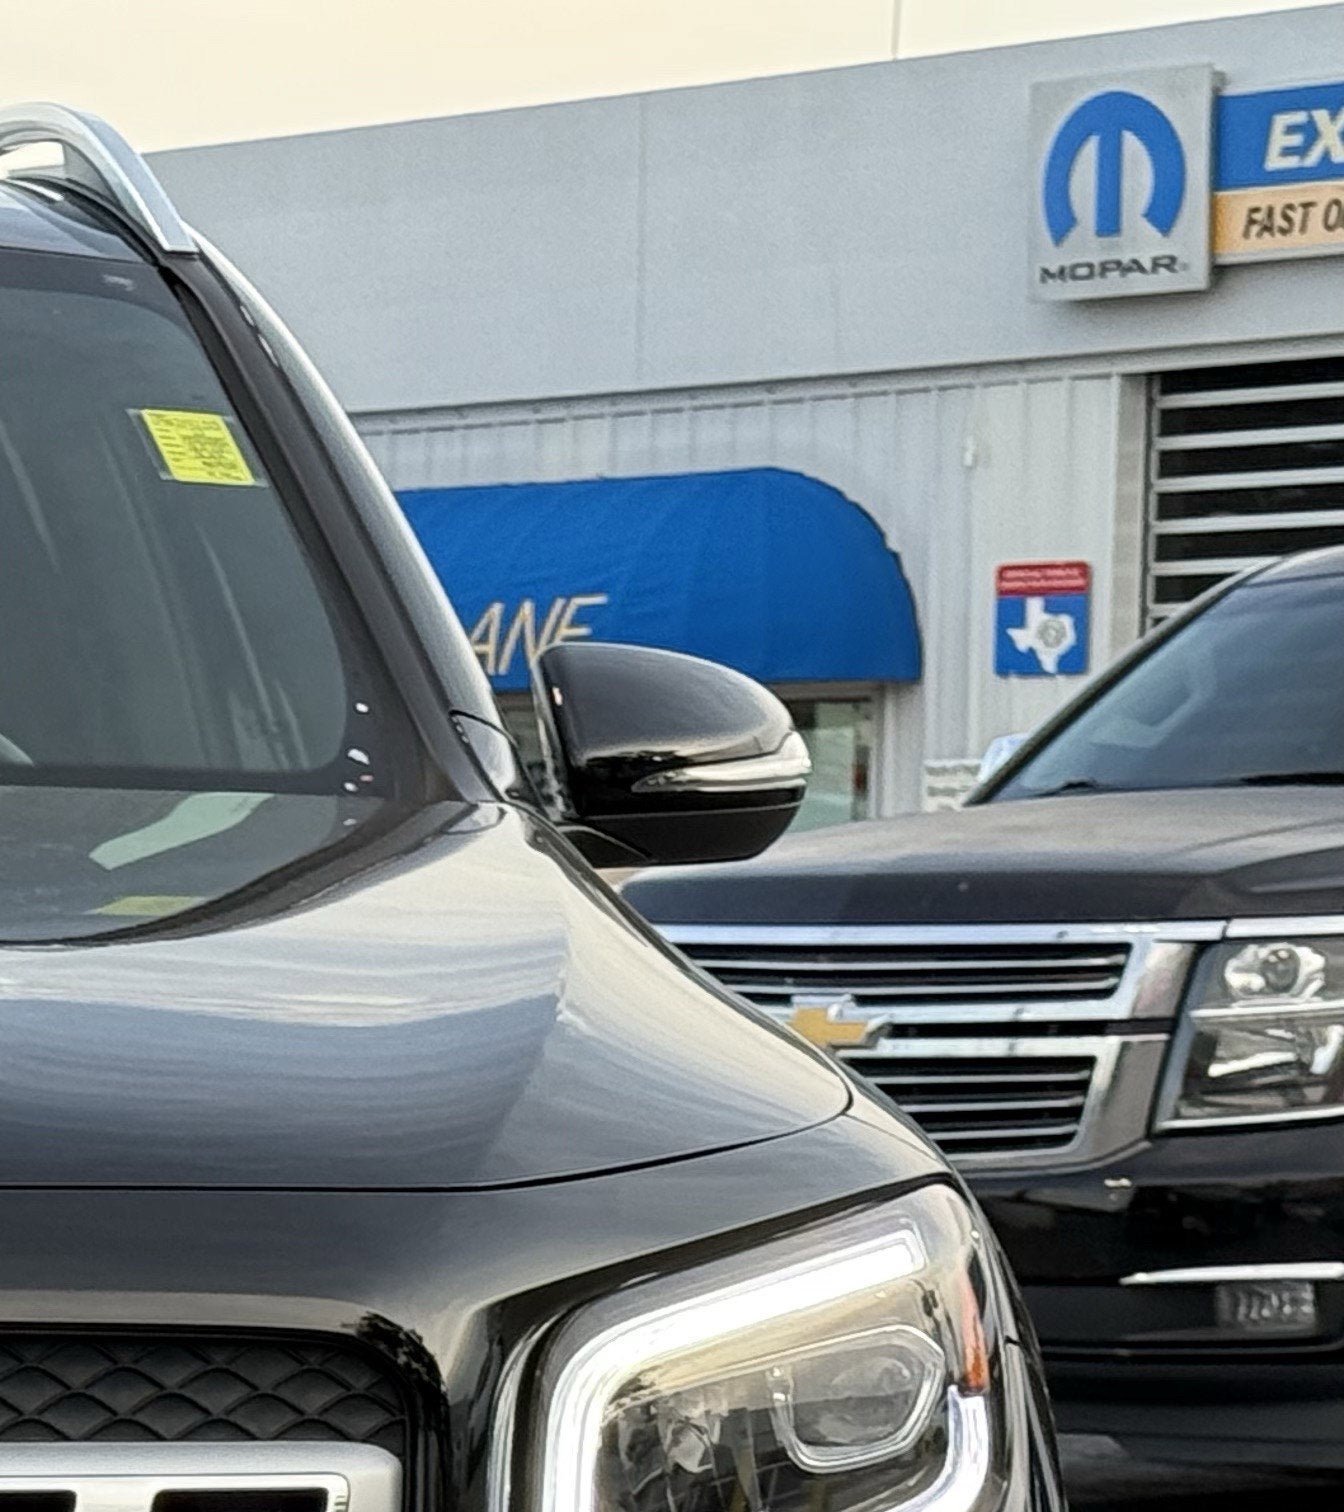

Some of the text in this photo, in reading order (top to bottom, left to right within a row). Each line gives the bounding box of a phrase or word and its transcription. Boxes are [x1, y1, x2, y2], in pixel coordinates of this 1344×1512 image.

[1242, 198, 1344, 240] FAST O
[1039, 254, 1179, 284] MOPAR
